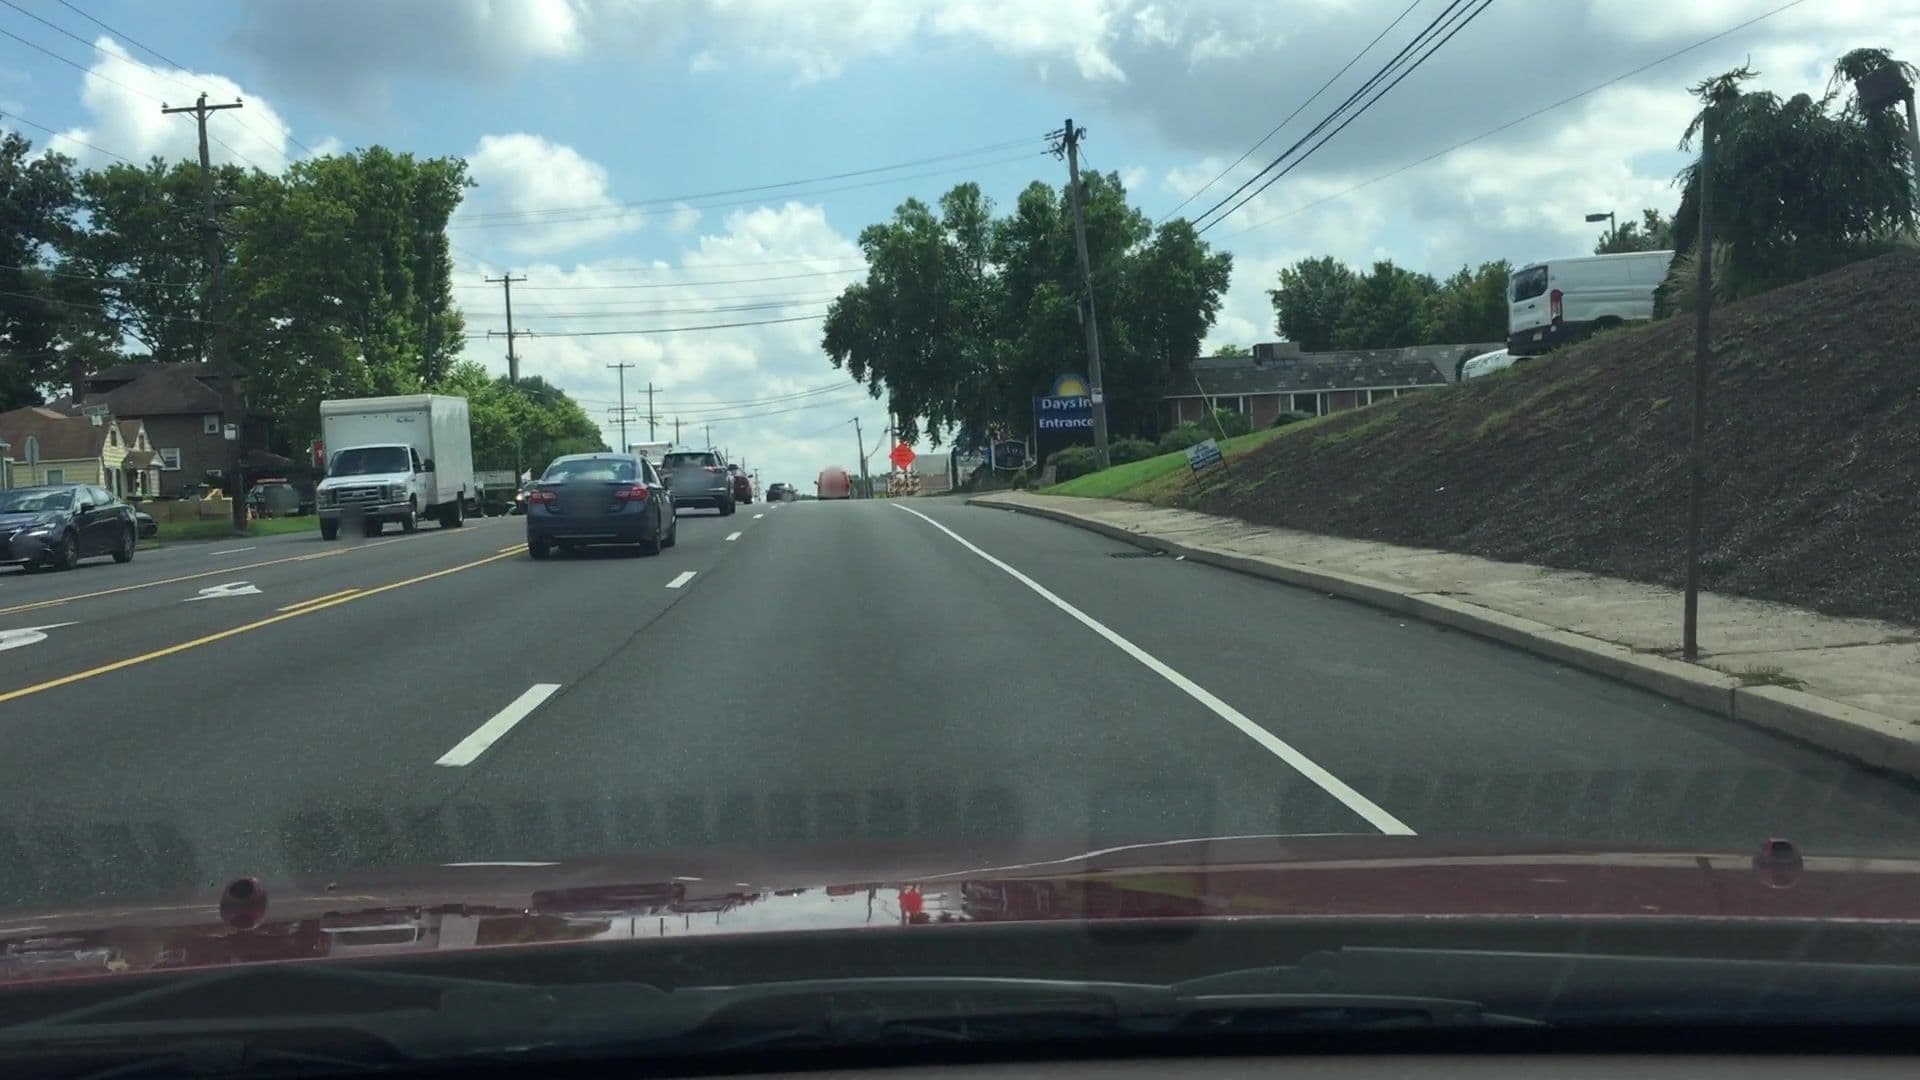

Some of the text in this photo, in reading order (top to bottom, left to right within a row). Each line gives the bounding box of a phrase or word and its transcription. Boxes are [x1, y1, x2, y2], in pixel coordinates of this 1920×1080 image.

[1042, 397, 1093, 410] Days In
[1040, 418, 1095, 428] Entrance
